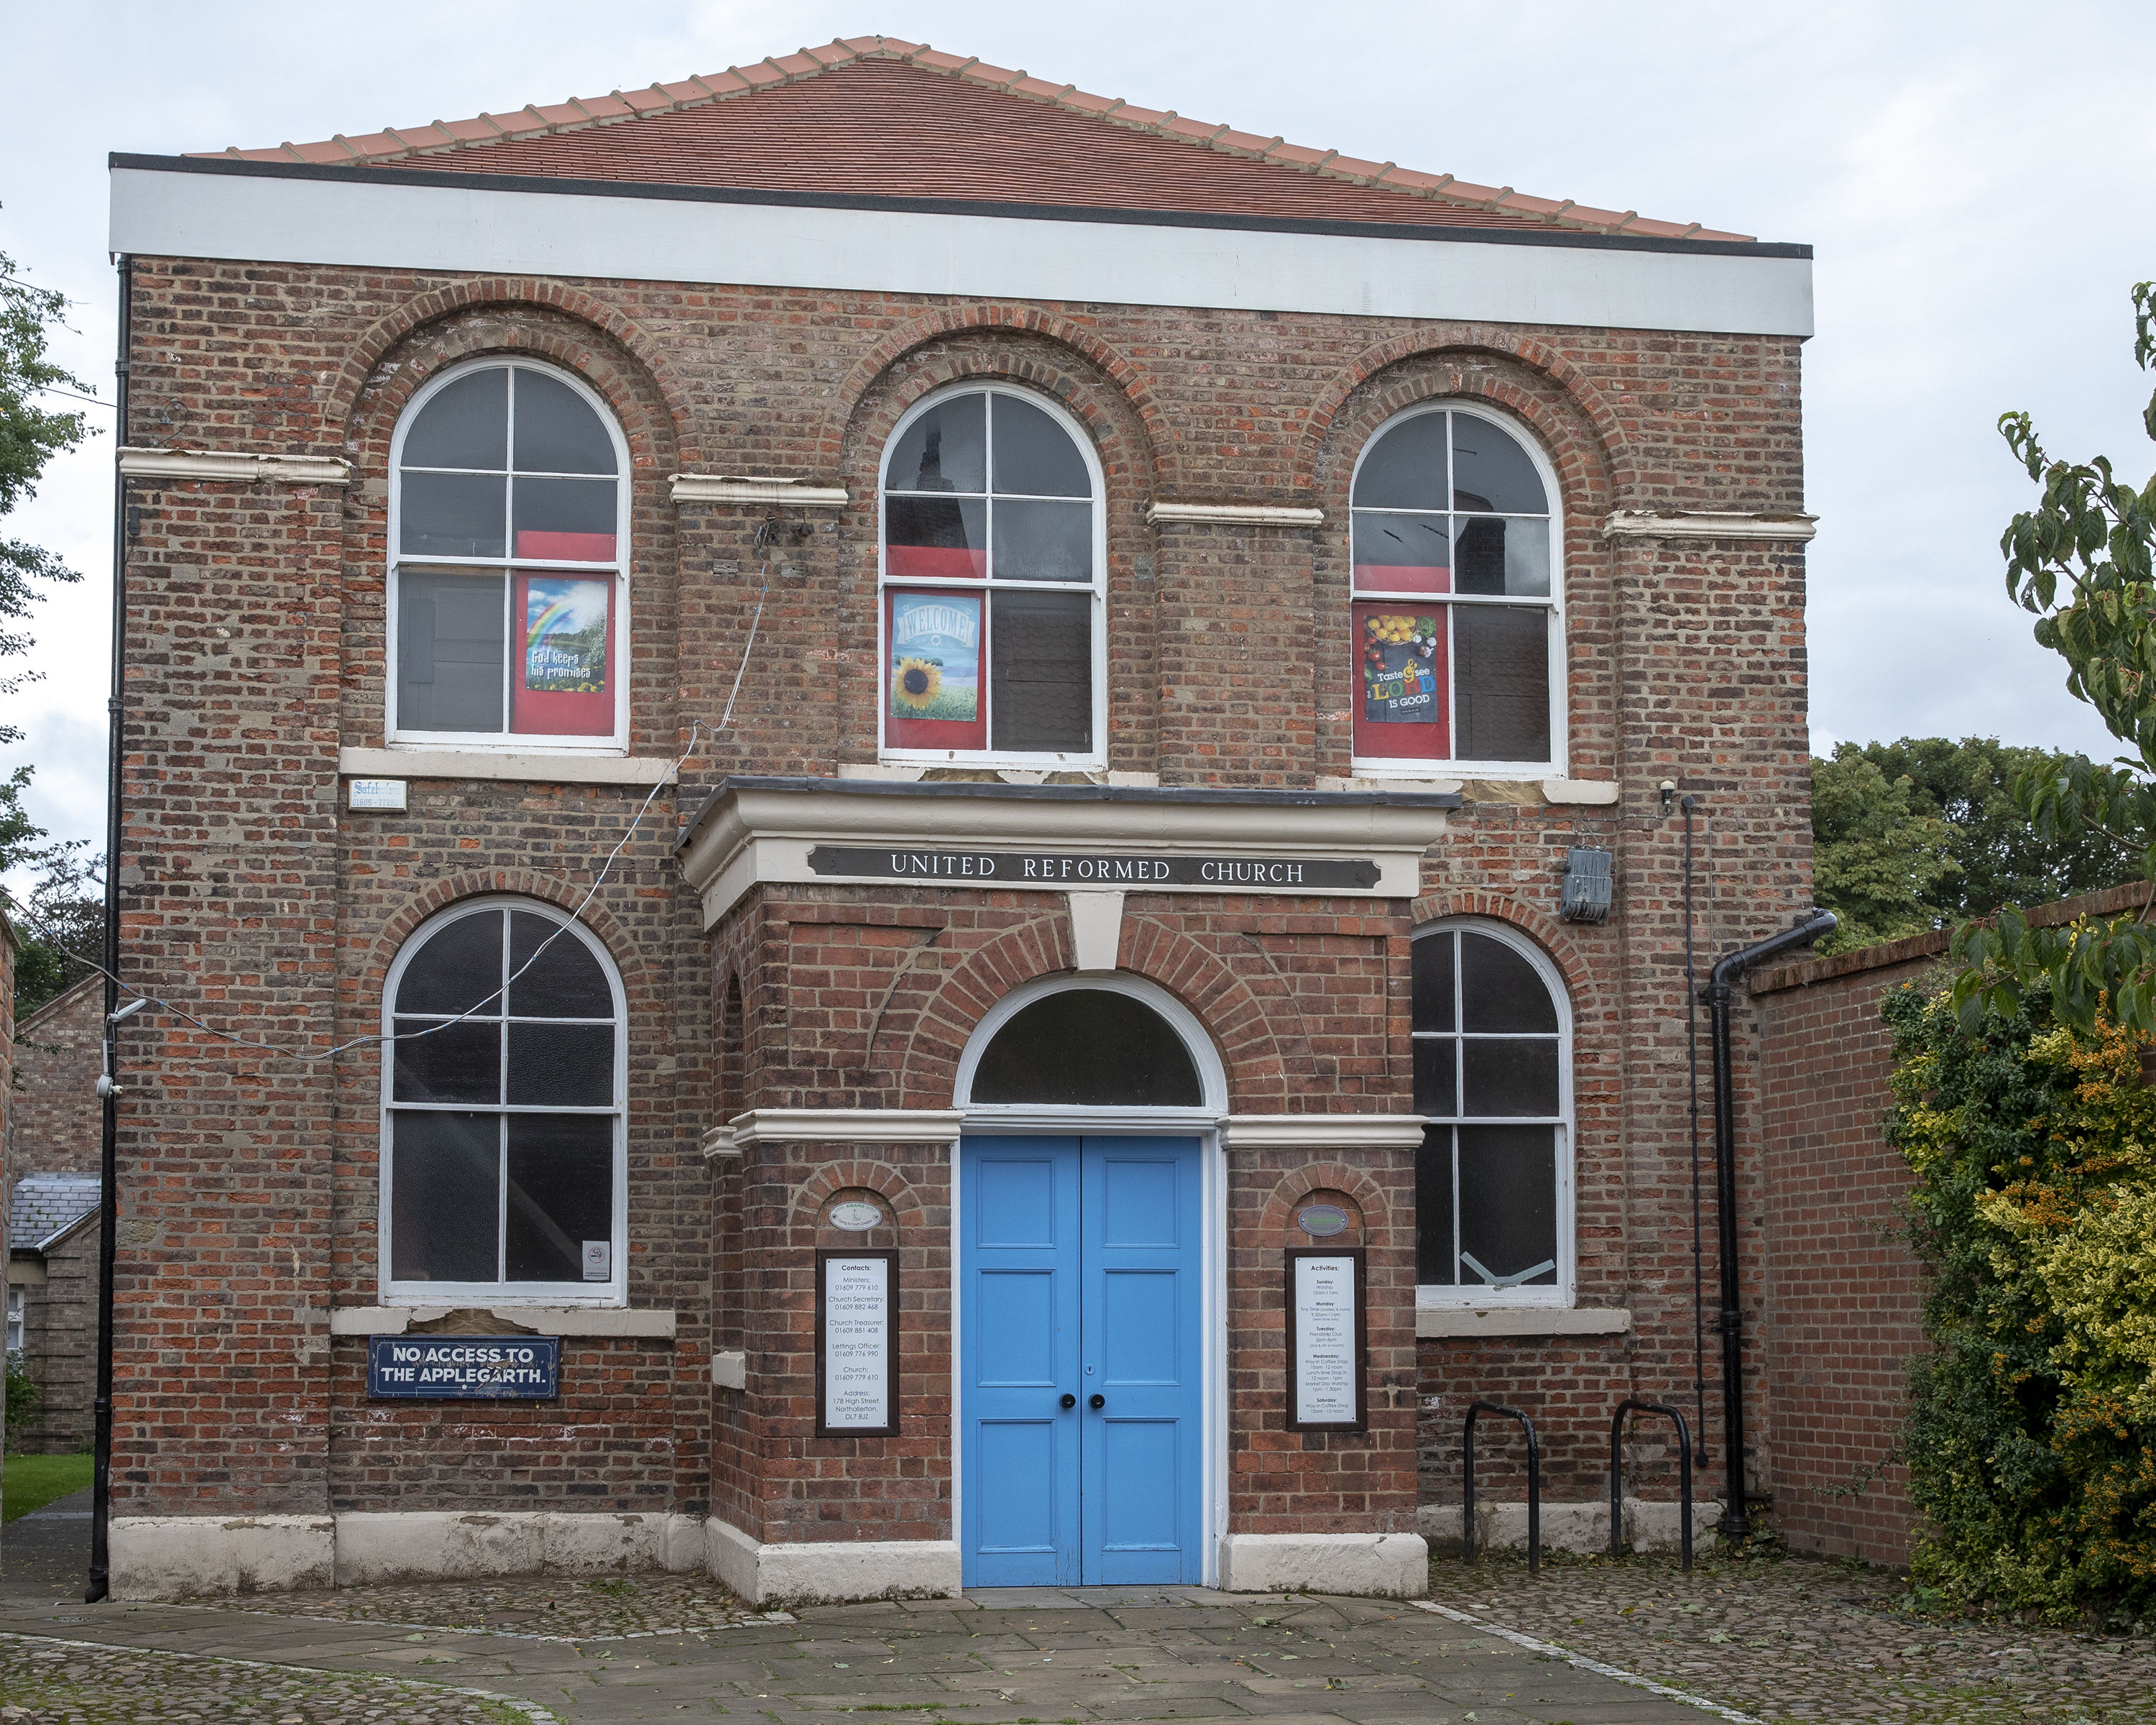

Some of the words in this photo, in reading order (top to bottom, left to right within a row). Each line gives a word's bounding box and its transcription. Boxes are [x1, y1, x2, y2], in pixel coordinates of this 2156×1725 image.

[908, 607, 967, 638] WELCOME
[532, 650, 550, 663] God
[553, 651, 579, 667] keeps
[532, 664, 544, 676] his
[547, 667, 591, 679] promises
[1377, 671, 1403, 682] Taste
[1403, 658, 1418, 683] &
[1371, 676, 1436, 701] LORD
[1388, 699, 1398, 709] IS
[1400, 694, 1430, 707] GOOD
[891, 854, 995, 875] UNITED
[1023, 859, 1170, 880] REFORMED
[1201, 862, 1304, 882] CHURCH
[393, 1347, 421, 1362] NO
[425, 1348, 501, 1363] ACCESS
[505, 1348, 534, 1363] TO
[380, 1367, 415, 1381] THE
[419, 1368, 546, 1383] APPLEGARTH.
